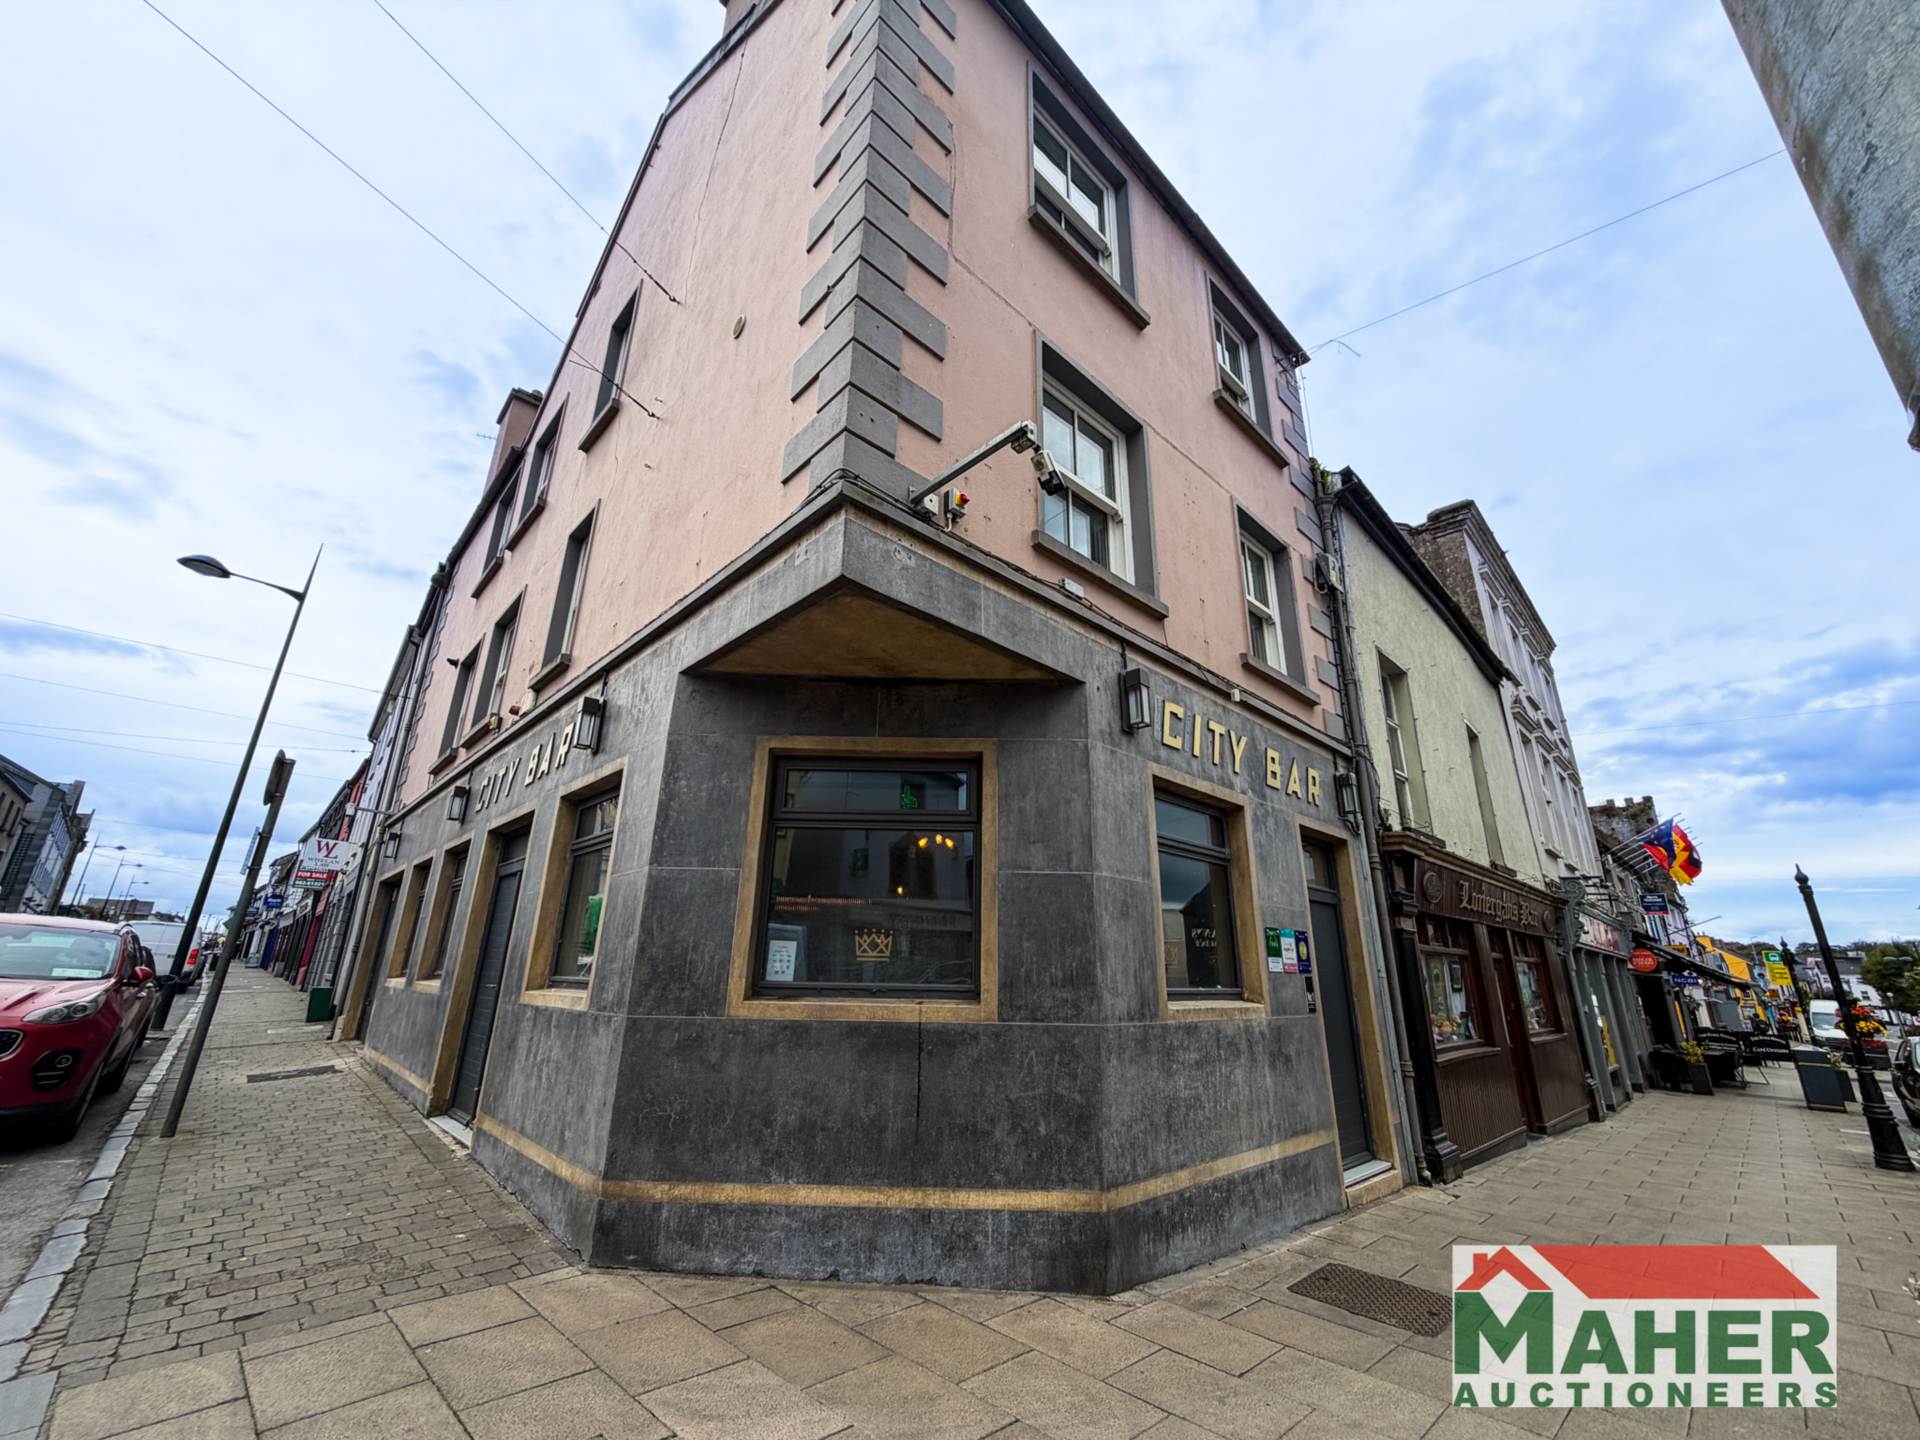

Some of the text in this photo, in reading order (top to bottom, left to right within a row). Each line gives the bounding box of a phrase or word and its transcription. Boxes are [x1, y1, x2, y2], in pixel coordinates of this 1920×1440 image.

[475, 722, 576, 813] CITY BAR
[1162, 699, 1320, 807] CITY BAR
[311, 871, 328, 879] SALE
[1520, 900, 1538, 927] Bar
